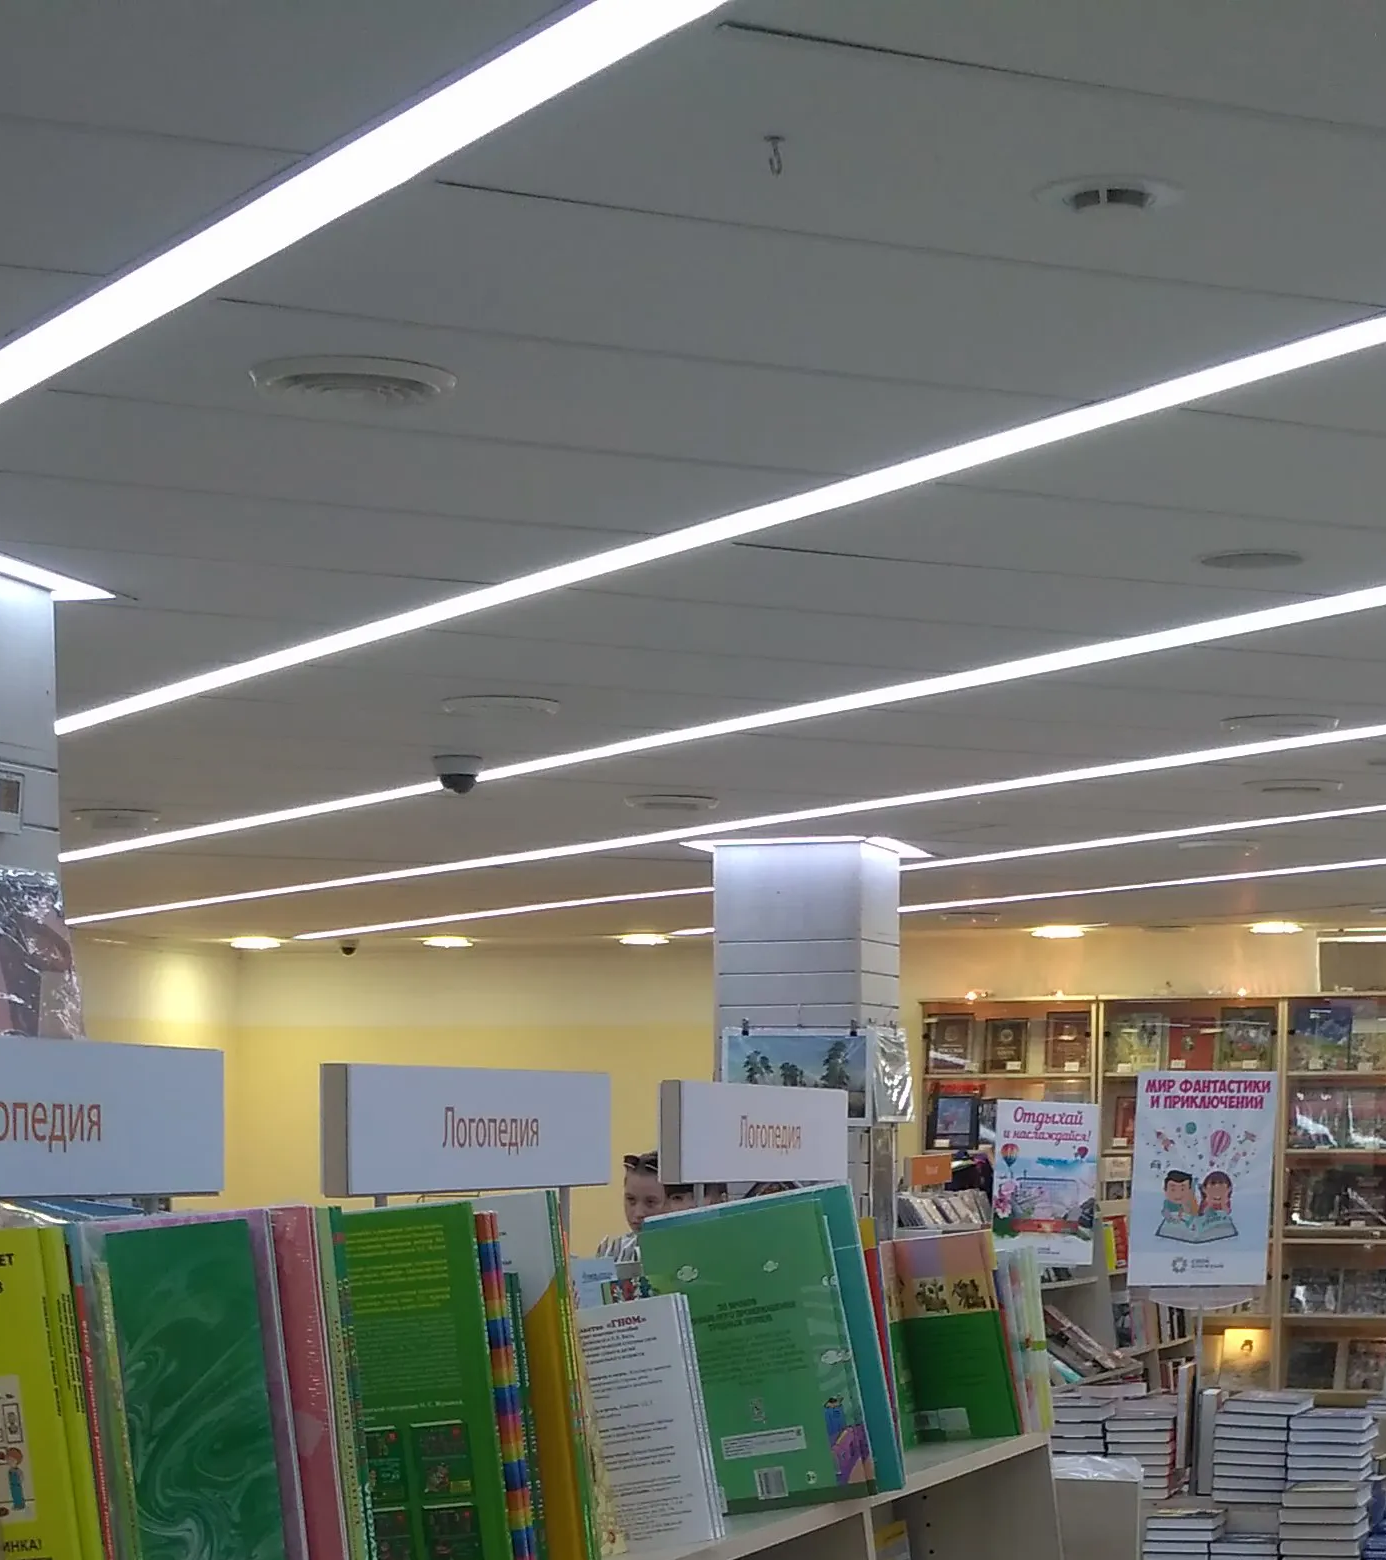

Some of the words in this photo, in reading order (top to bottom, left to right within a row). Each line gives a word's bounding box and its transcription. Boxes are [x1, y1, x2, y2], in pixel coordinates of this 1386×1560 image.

[1145, 1080, 1176, 1094] МИР
[1179, 1079, 1271, 1094] ФАНТАСТИКИ
[1149, 1096, 1161, 1109] И
[1163, 1094, 1265, 1110] ПРИКЛЮЧЕНИЙ
[1013, 1106, 1084, 1129] Отдыхай
[442, 1107, 539, 1155] Логопедия
[739, 1115, 801, 1155] Логопедия
[1014, 1129, 1092, 1146] наслаждайся!
[606, 1314, 647, 1330] «ГНОМ»
